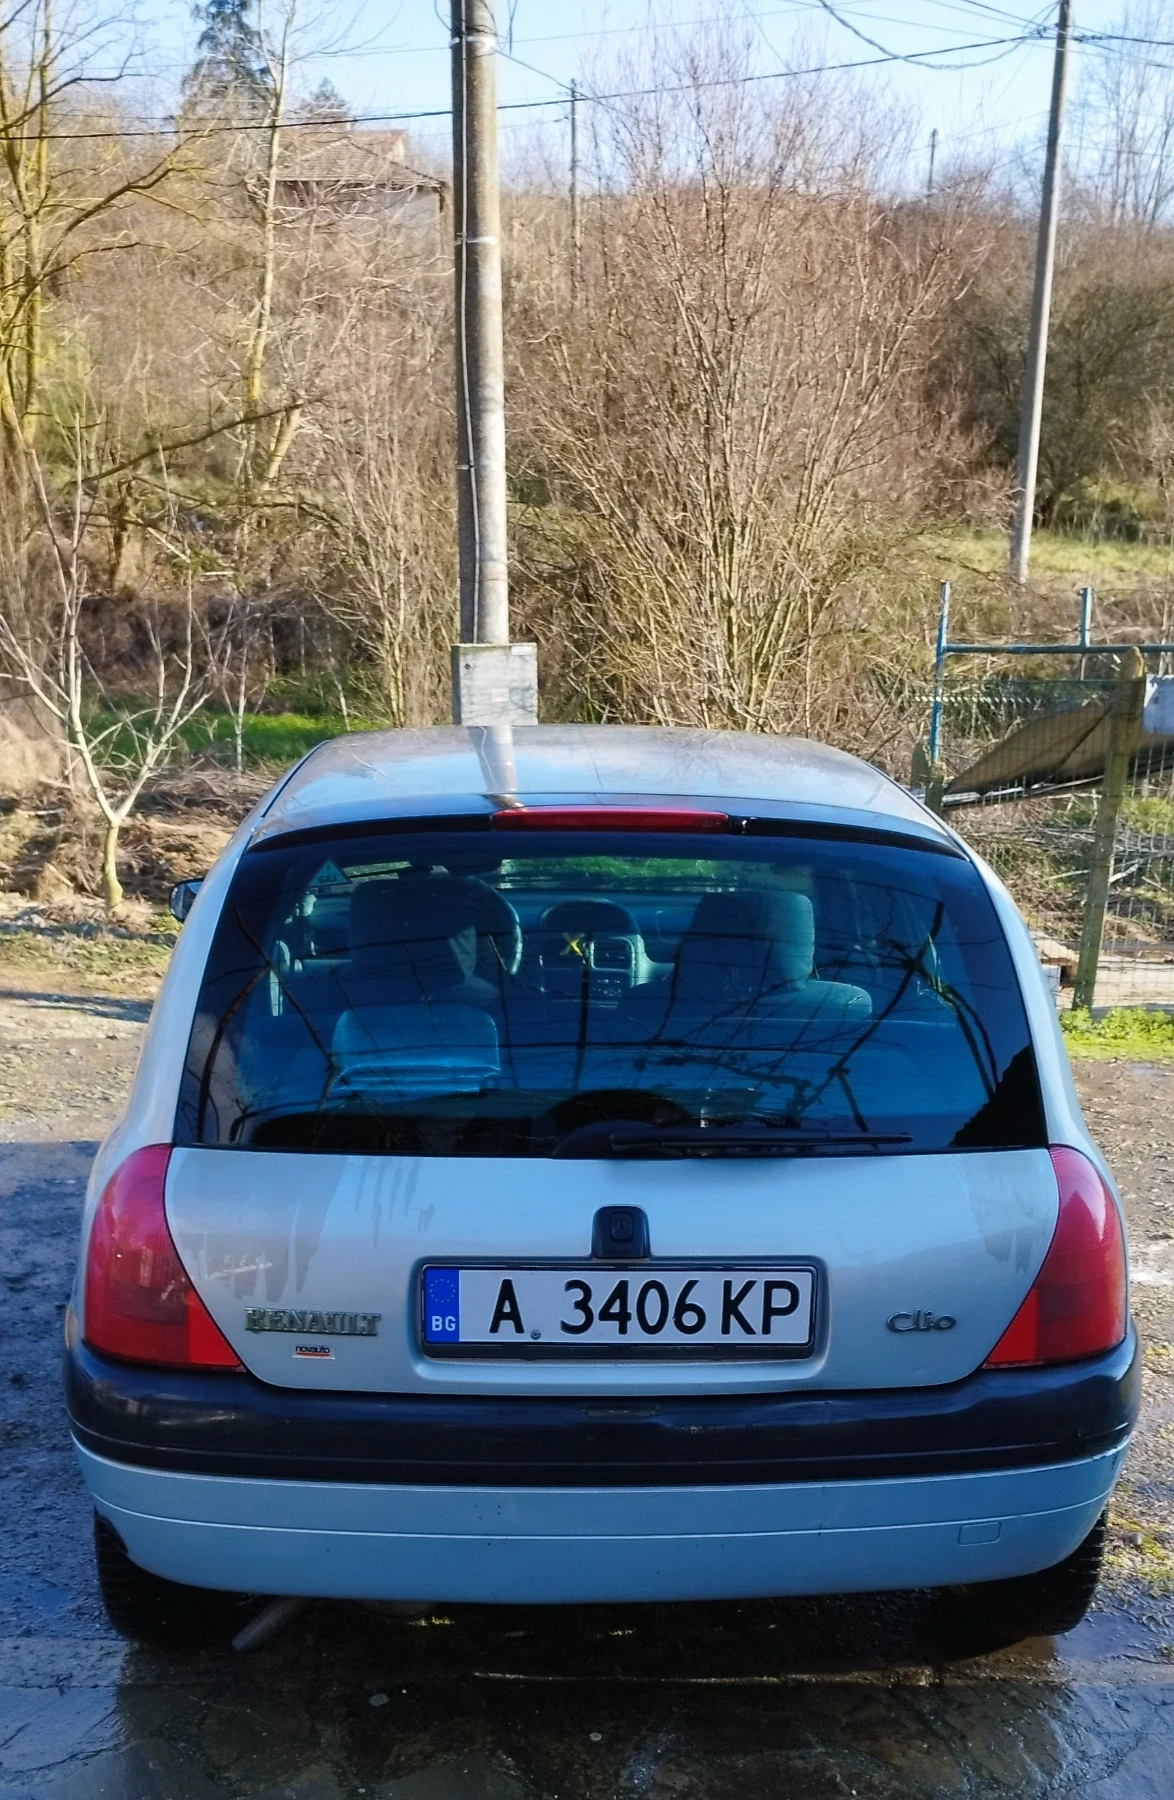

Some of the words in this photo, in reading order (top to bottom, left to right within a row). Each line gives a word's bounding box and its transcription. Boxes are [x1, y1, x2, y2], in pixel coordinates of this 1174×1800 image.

[489, 1278, 525, 1334] A
[560, 1279, 706, 1335] 3406
[721, 1279, 800, 1335] KP
[244, 1307, 381, 1336] RENAULT
[432, 1316, 456, 1331] BG
[886, 1308, 957, 1333] Clio
